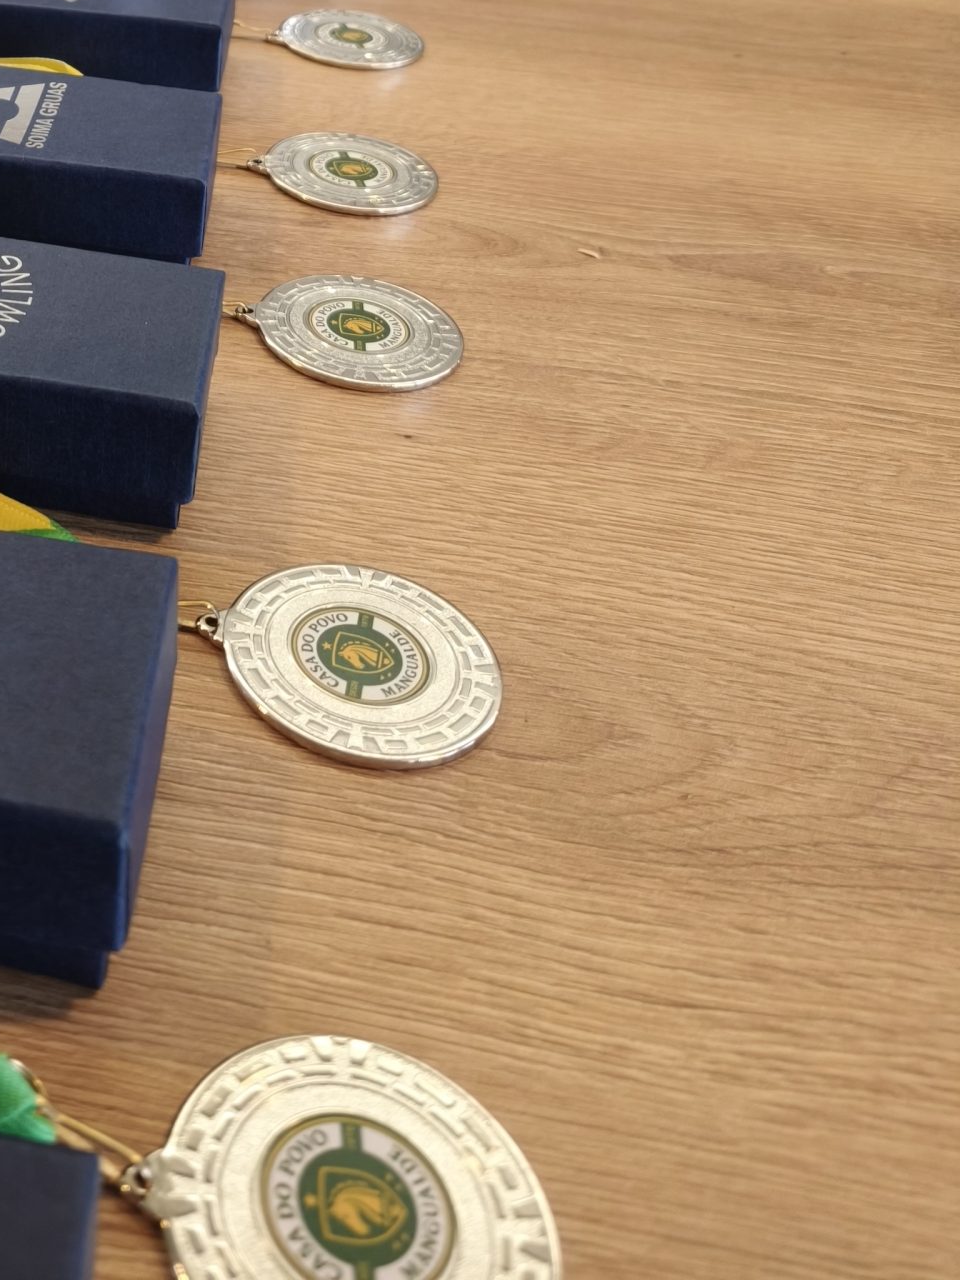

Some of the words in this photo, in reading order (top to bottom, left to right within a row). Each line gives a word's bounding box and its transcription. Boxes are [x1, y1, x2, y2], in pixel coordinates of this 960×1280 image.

[25, 115, 53, 150] SOIMA
[41, 81, 68, 118] GRUAS
[321, 301, 346, 316] POVO
[311, 612, 348, 634] POVO
[301, 635, 316, 652] DO
[307, 656, 340, 689] CASA
[381, 630, 419, 698] MANGUALDE
[280, 1129, 326, 1176] POVO
[276, 1183, 295, 1219] DO
[390, 1147, 440, 1276] MANGUALDE
